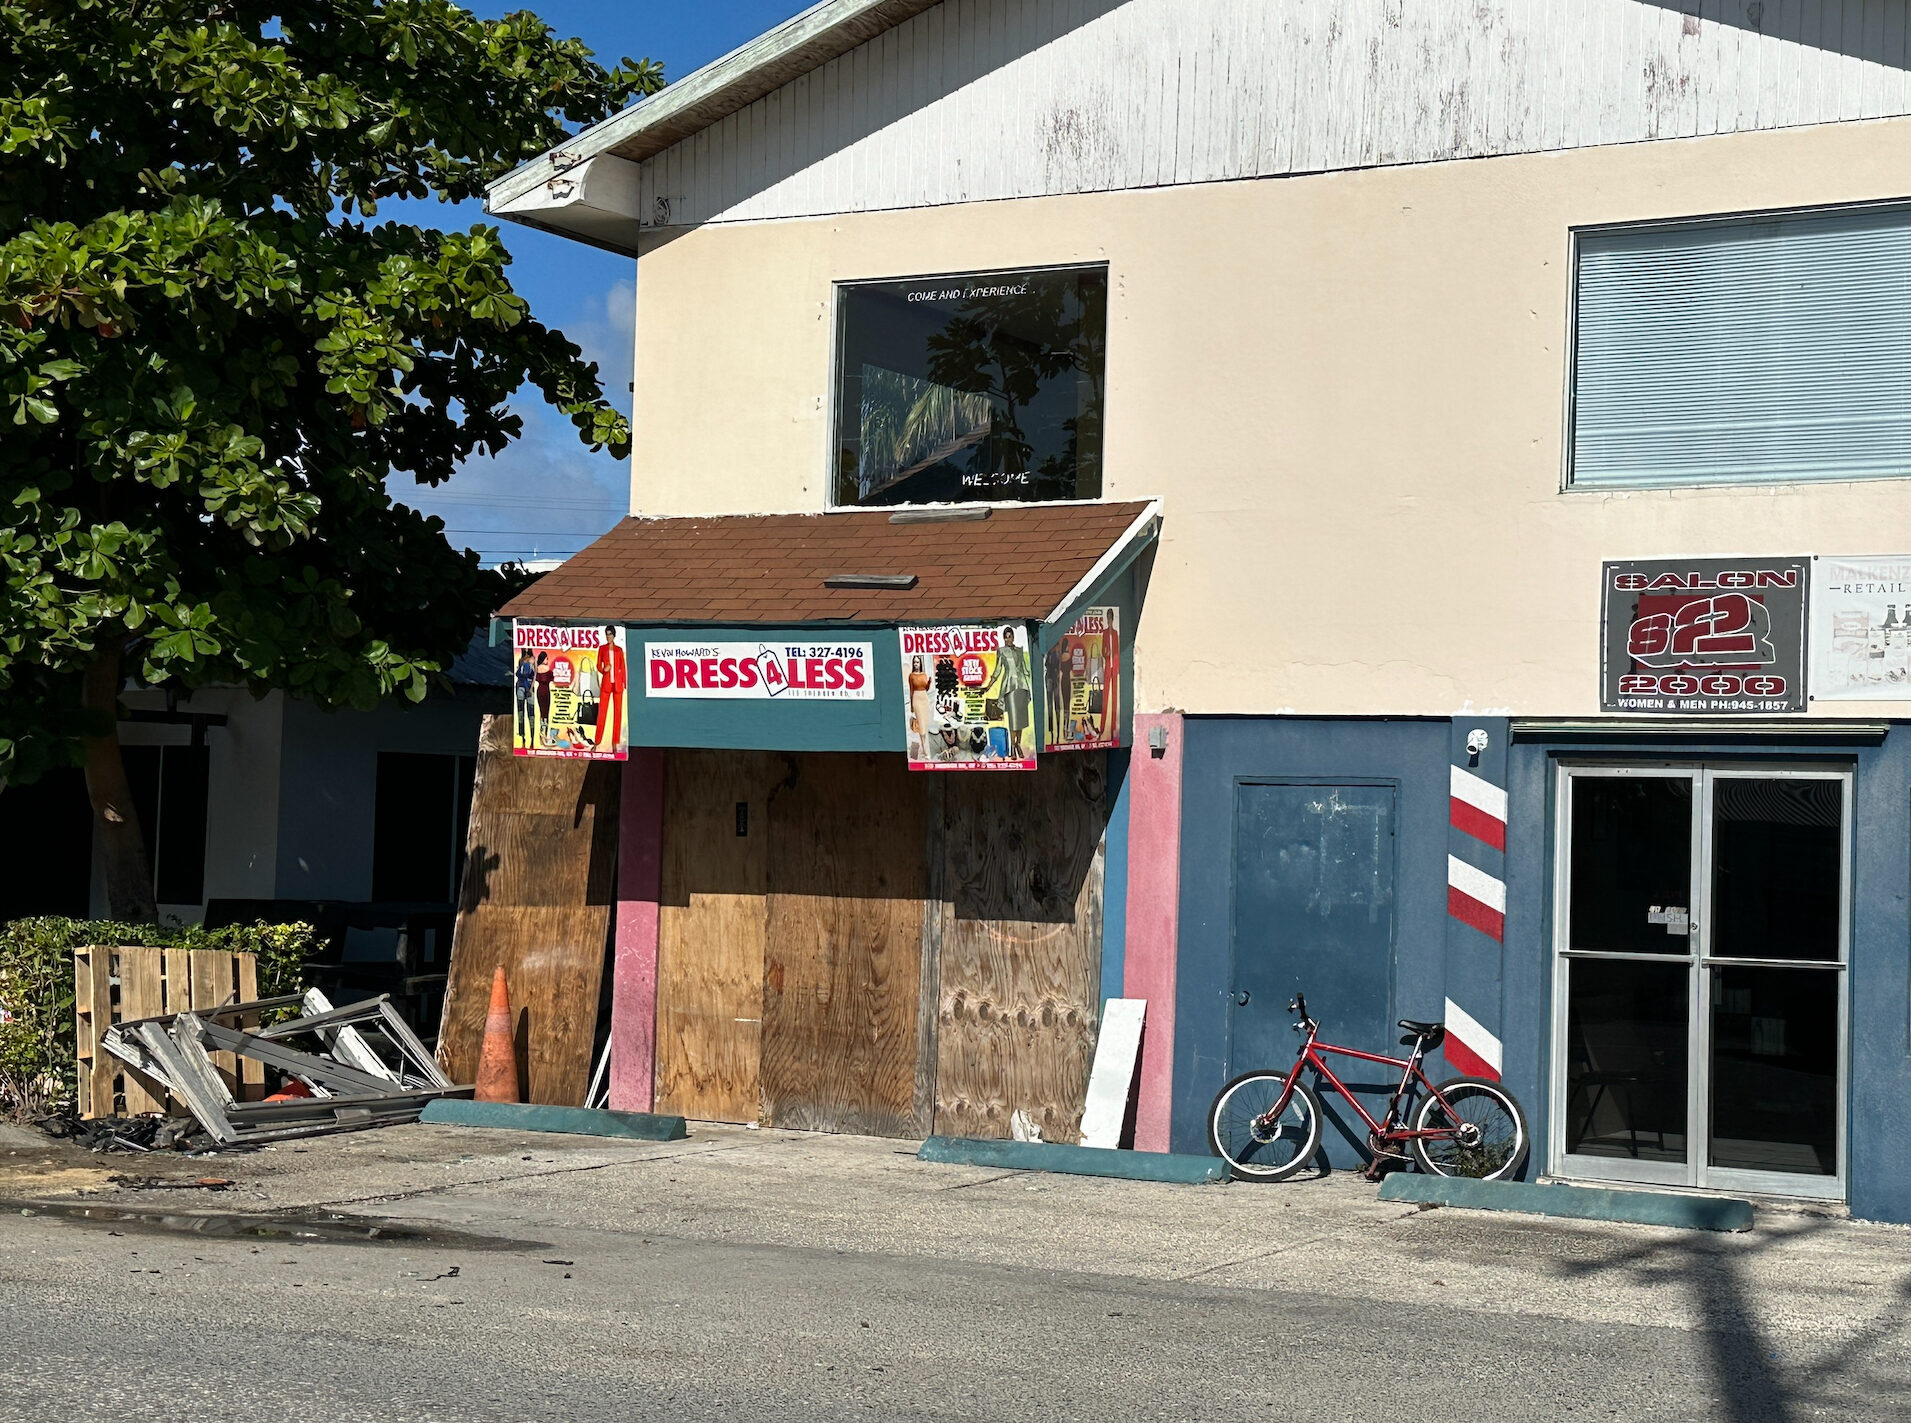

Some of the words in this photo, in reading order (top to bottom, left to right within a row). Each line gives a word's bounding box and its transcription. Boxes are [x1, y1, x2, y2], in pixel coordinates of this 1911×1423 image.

[938, 289, 960, 300] AND
[1614, 570, 1797, 591] SALON
[1843, 583, 1906, 593] RETAIL
[516, 628, 558, 647] DRESS
[571, 629, 600, 648] LESS
[904, 632, 949, 653] DRESS
[965, 631, 999, 652] LESS
[785, 647, 806, 658] TEL:
[809, 647, 863, 658] 327-4196
[650, 658, 758, 689] DRESS
[766, 660, 782, 685] 4
[788, 658, 865, 690] LESS
[1618, 675, 1787, 696] 2000
[1617, 699, 1664, 709] WOMEN
[1667, 700, 1676, 709] &
[1680, 700, 1706, 709] MEN
